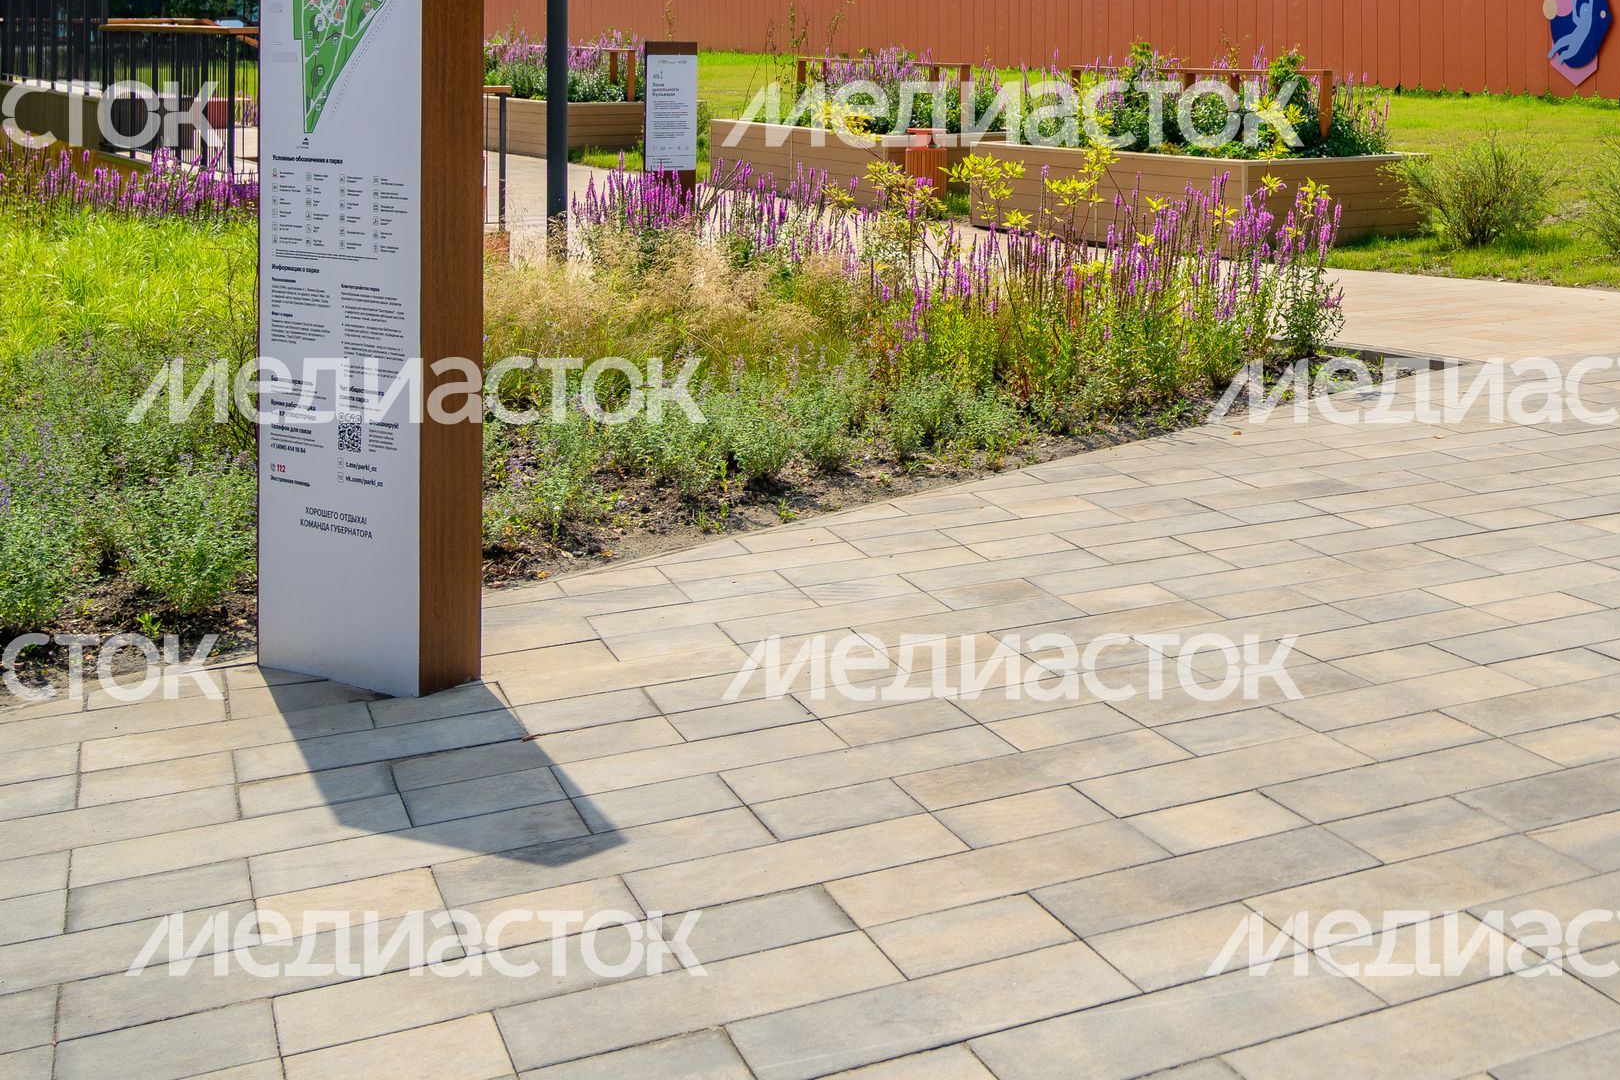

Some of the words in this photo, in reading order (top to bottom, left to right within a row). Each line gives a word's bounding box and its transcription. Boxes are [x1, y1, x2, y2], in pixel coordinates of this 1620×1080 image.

[276, 463, 286, 473] 112
[305, 506, 339, 520] ХОРОШЕГО
[339, 512, 368, 525] ОТДЫХА!
[299, 518, 330, 532] КОМАНДА
[330, 523, 373, 539] ГУБЕРНАТОРА
